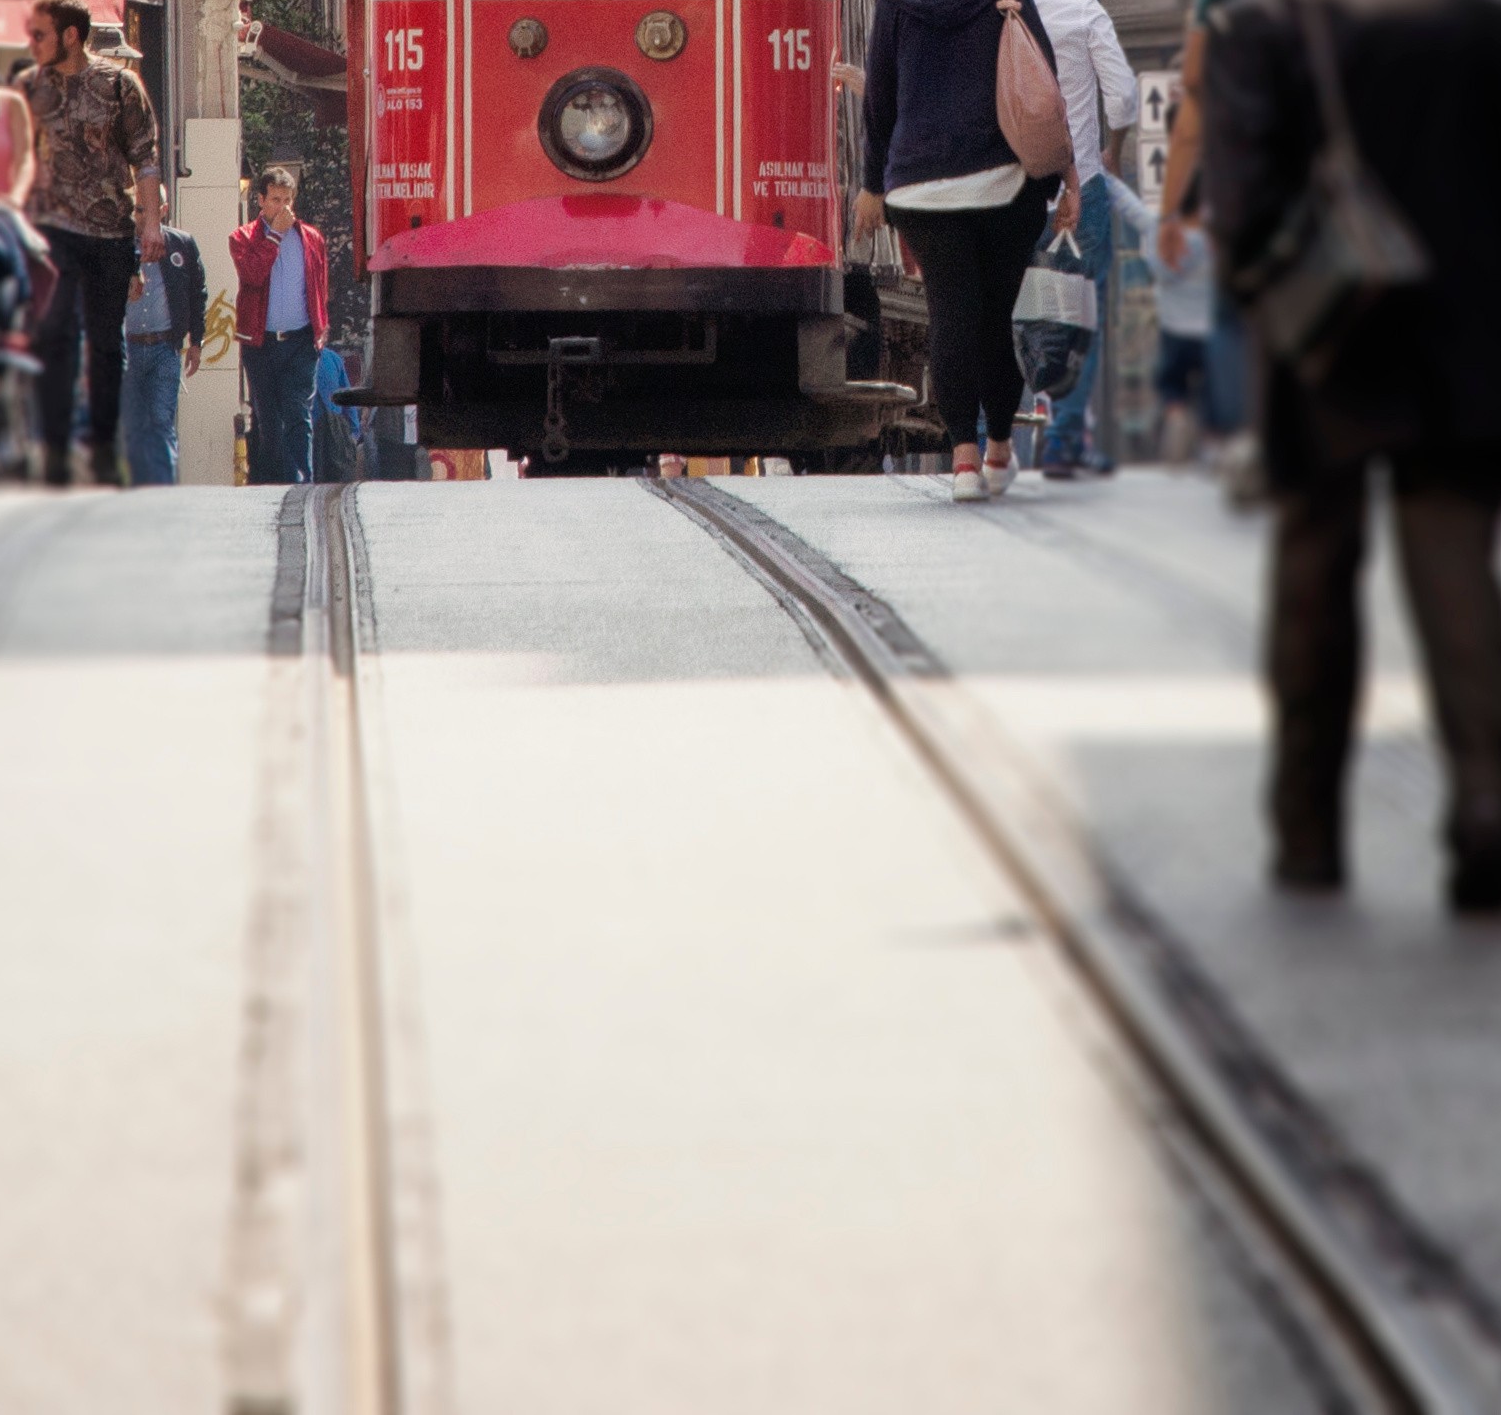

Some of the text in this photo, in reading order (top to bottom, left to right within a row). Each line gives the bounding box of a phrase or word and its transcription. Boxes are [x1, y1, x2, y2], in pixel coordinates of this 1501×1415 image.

[384, 28, 424, 72] 115
[767, 28, 811, 71] 115
[399, 162, 431, 179] YASAK
[753, 180, 769, 198] VE
